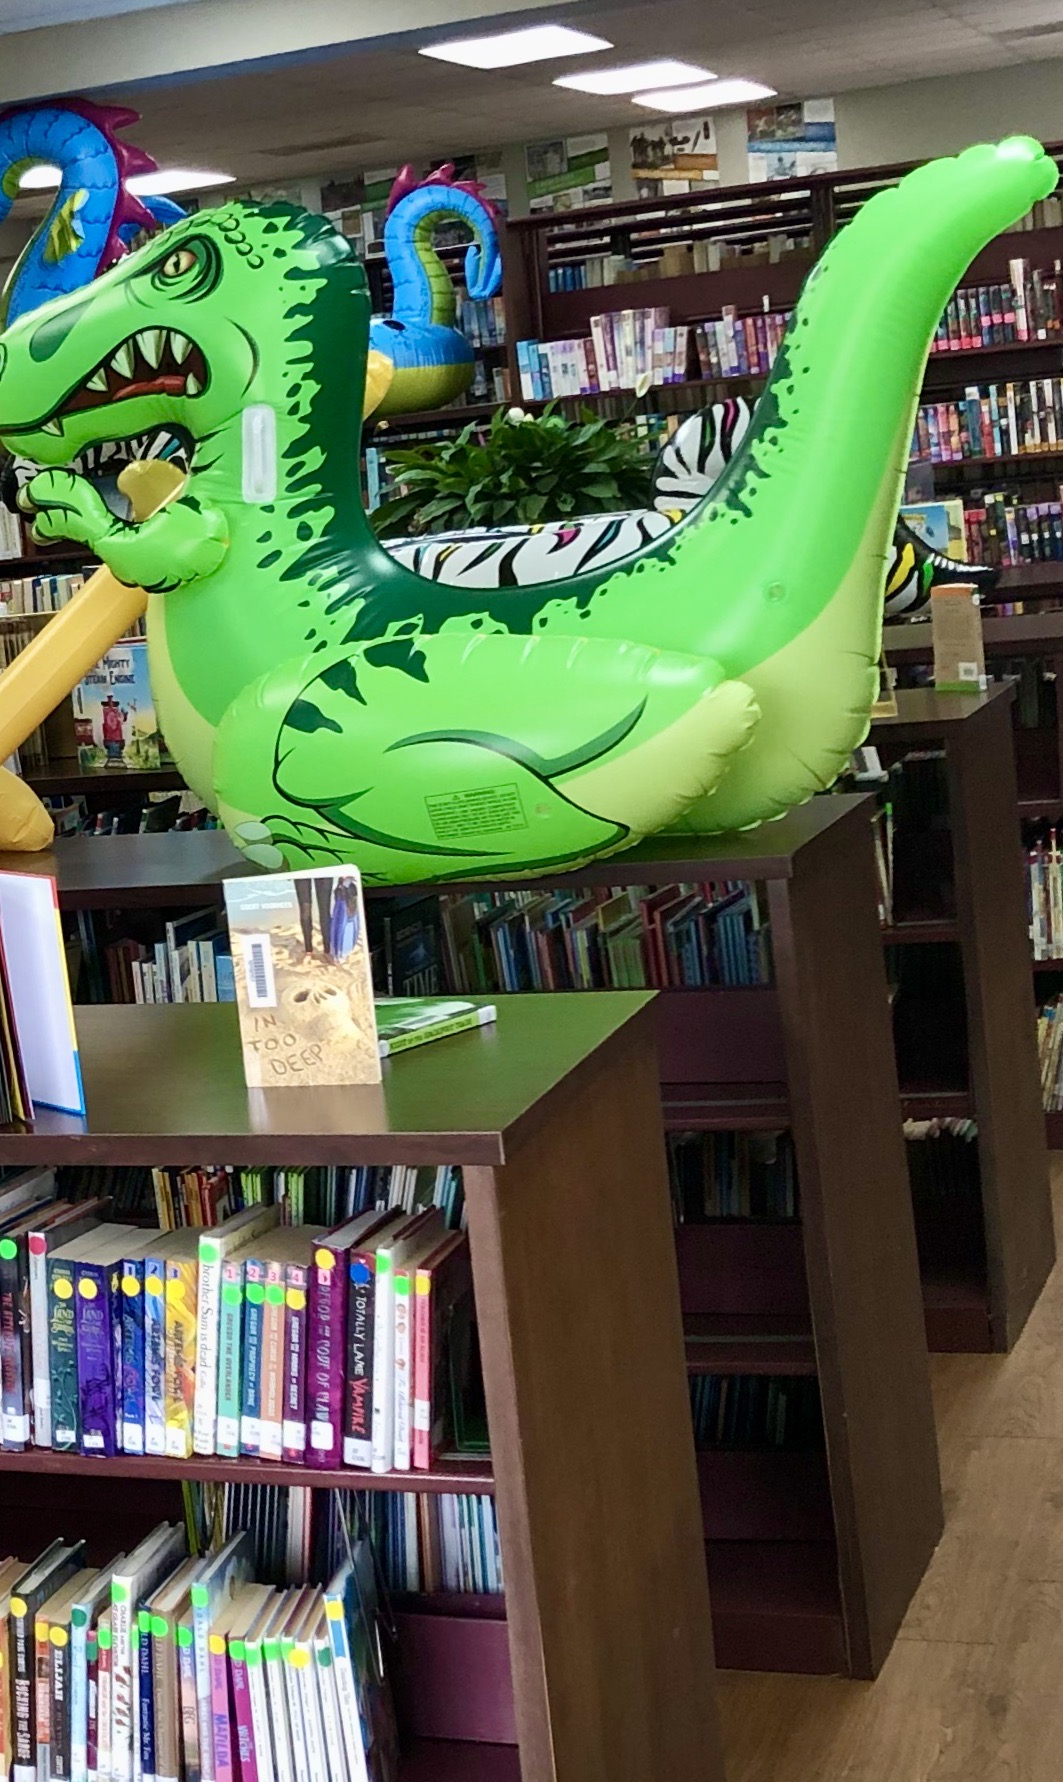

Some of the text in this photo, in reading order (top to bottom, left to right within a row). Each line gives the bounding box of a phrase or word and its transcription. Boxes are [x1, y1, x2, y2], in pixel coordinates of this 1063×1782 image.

[254, 1014, 277, 1031] IN
[248, 1033, 297, 1053] TOO
[270, 1043, 323, 1075] DEEP
[202, 1265, 214, 1305] brother
[228, 1269, 233, 1278] 1
[249, 1269, 256, 1278] 2
[271, 1272, 277, 1281] 3
[292, 1270, 300, 1282] 4
[2, 1292, 14, 1306] THE
[201, 1306, 212, 1332] Sam
[123, 1314, 134, 1364] ARTEMIS
[151, 1320, 161, 1401] ARTEMIS FOWL
[200, 1343, 212, 1368] dead
[248, 1345, 256, 1381] PROPHECY
[317, 1340, 330, 1368] CODE
[349, 1296, 369, 1433] TOTALLY LAME VAMPIRE
[317, 1372, 330, 1388] OF
[119, 1606, 127, 1634] CHARLIE
[55, 1649, 64, 1701] ELIJAH
[141, 1648, 150, 1675] DAHL
[184, 1656, 192, 1679] DAHL
[15, 1679, 30, 1719] BUCKING
[235, 1670, 251, 1762] DAHL WITCHES
[17, 1732, 31, 1760] SARGE
[143, 1747, 151, 1760] Fox
[214, 1713, 229, 1768] MATILDA
[55, 1755, 64, 1775] CURTIS
